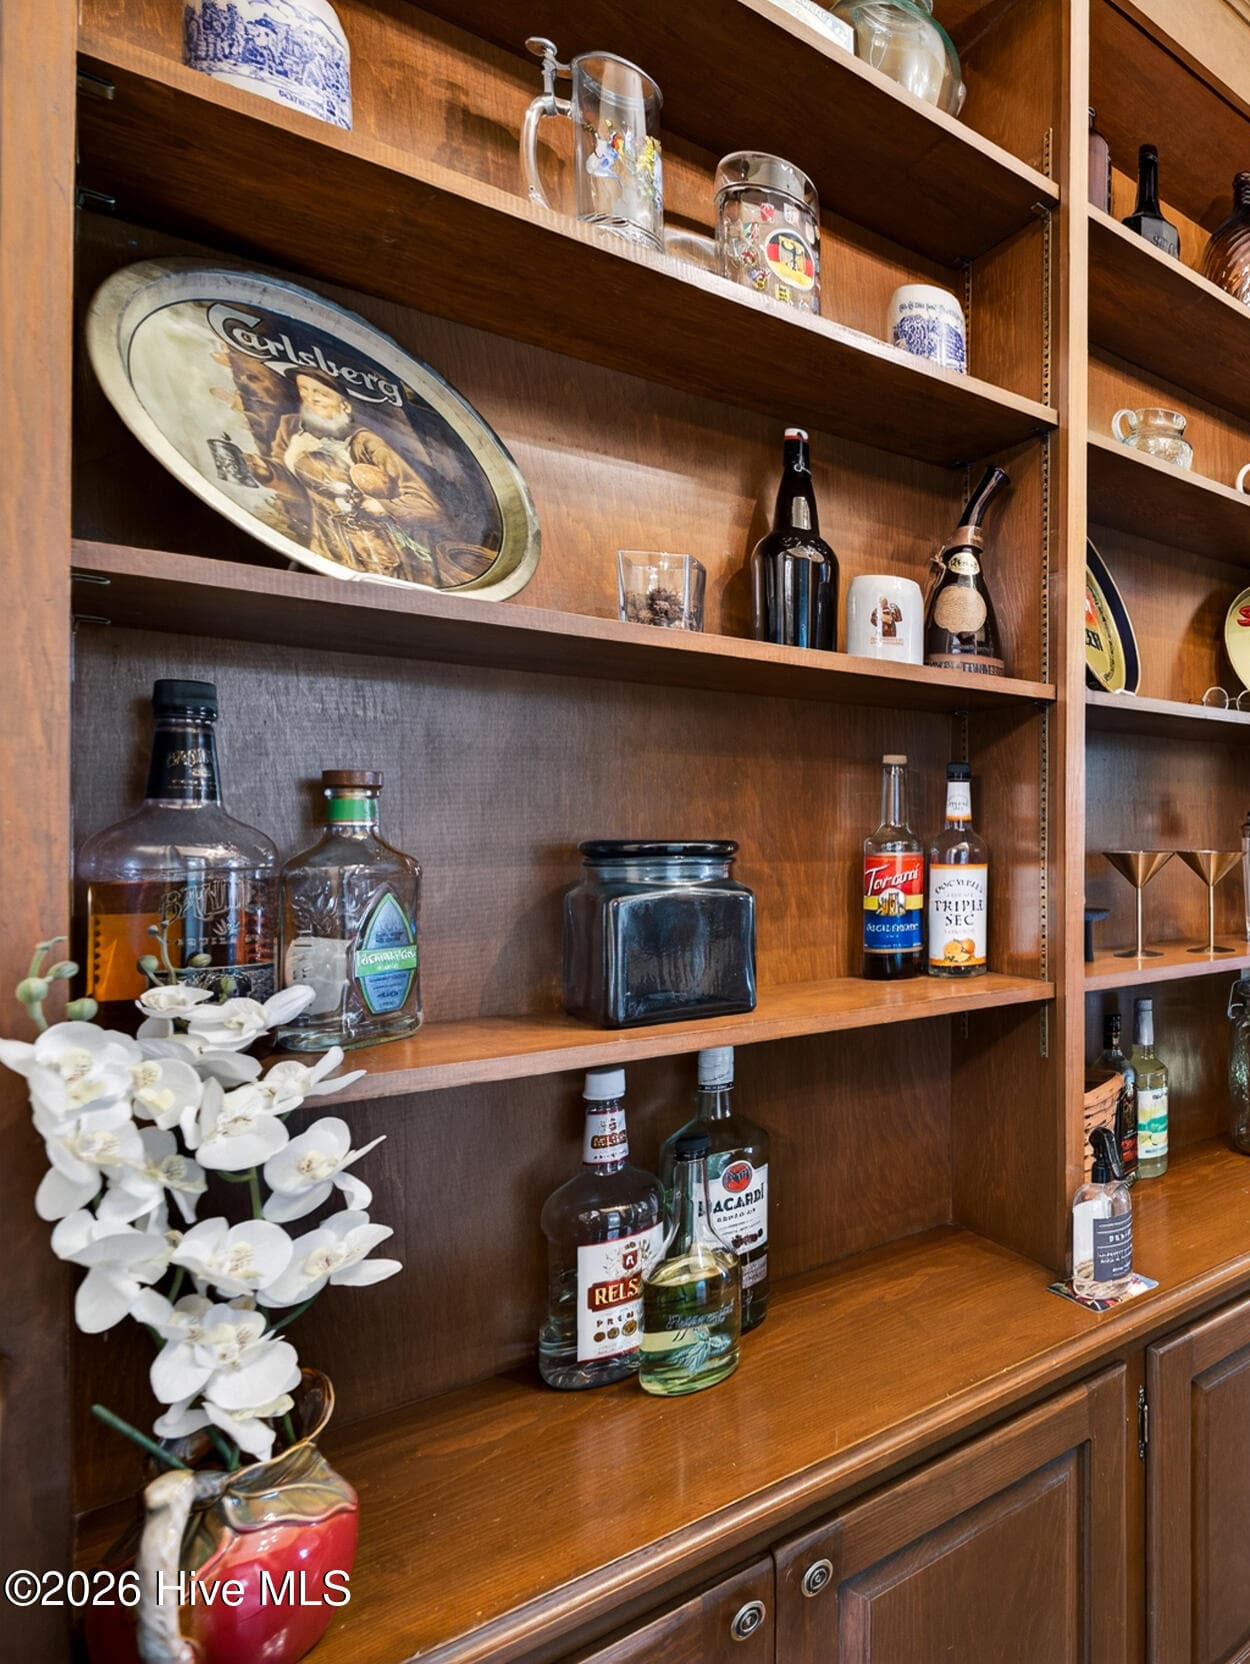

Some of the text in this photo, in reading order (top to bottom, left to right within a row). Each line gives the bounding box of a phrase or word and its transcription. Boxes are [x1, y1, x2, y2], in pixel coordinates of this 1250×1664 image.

[206, 302, 403, 407] Carlsberg
[865, 864, 919, 896] Torani
[945, 914, 974, 926] SEC
[595, 1278, 639, 1306] RELS
